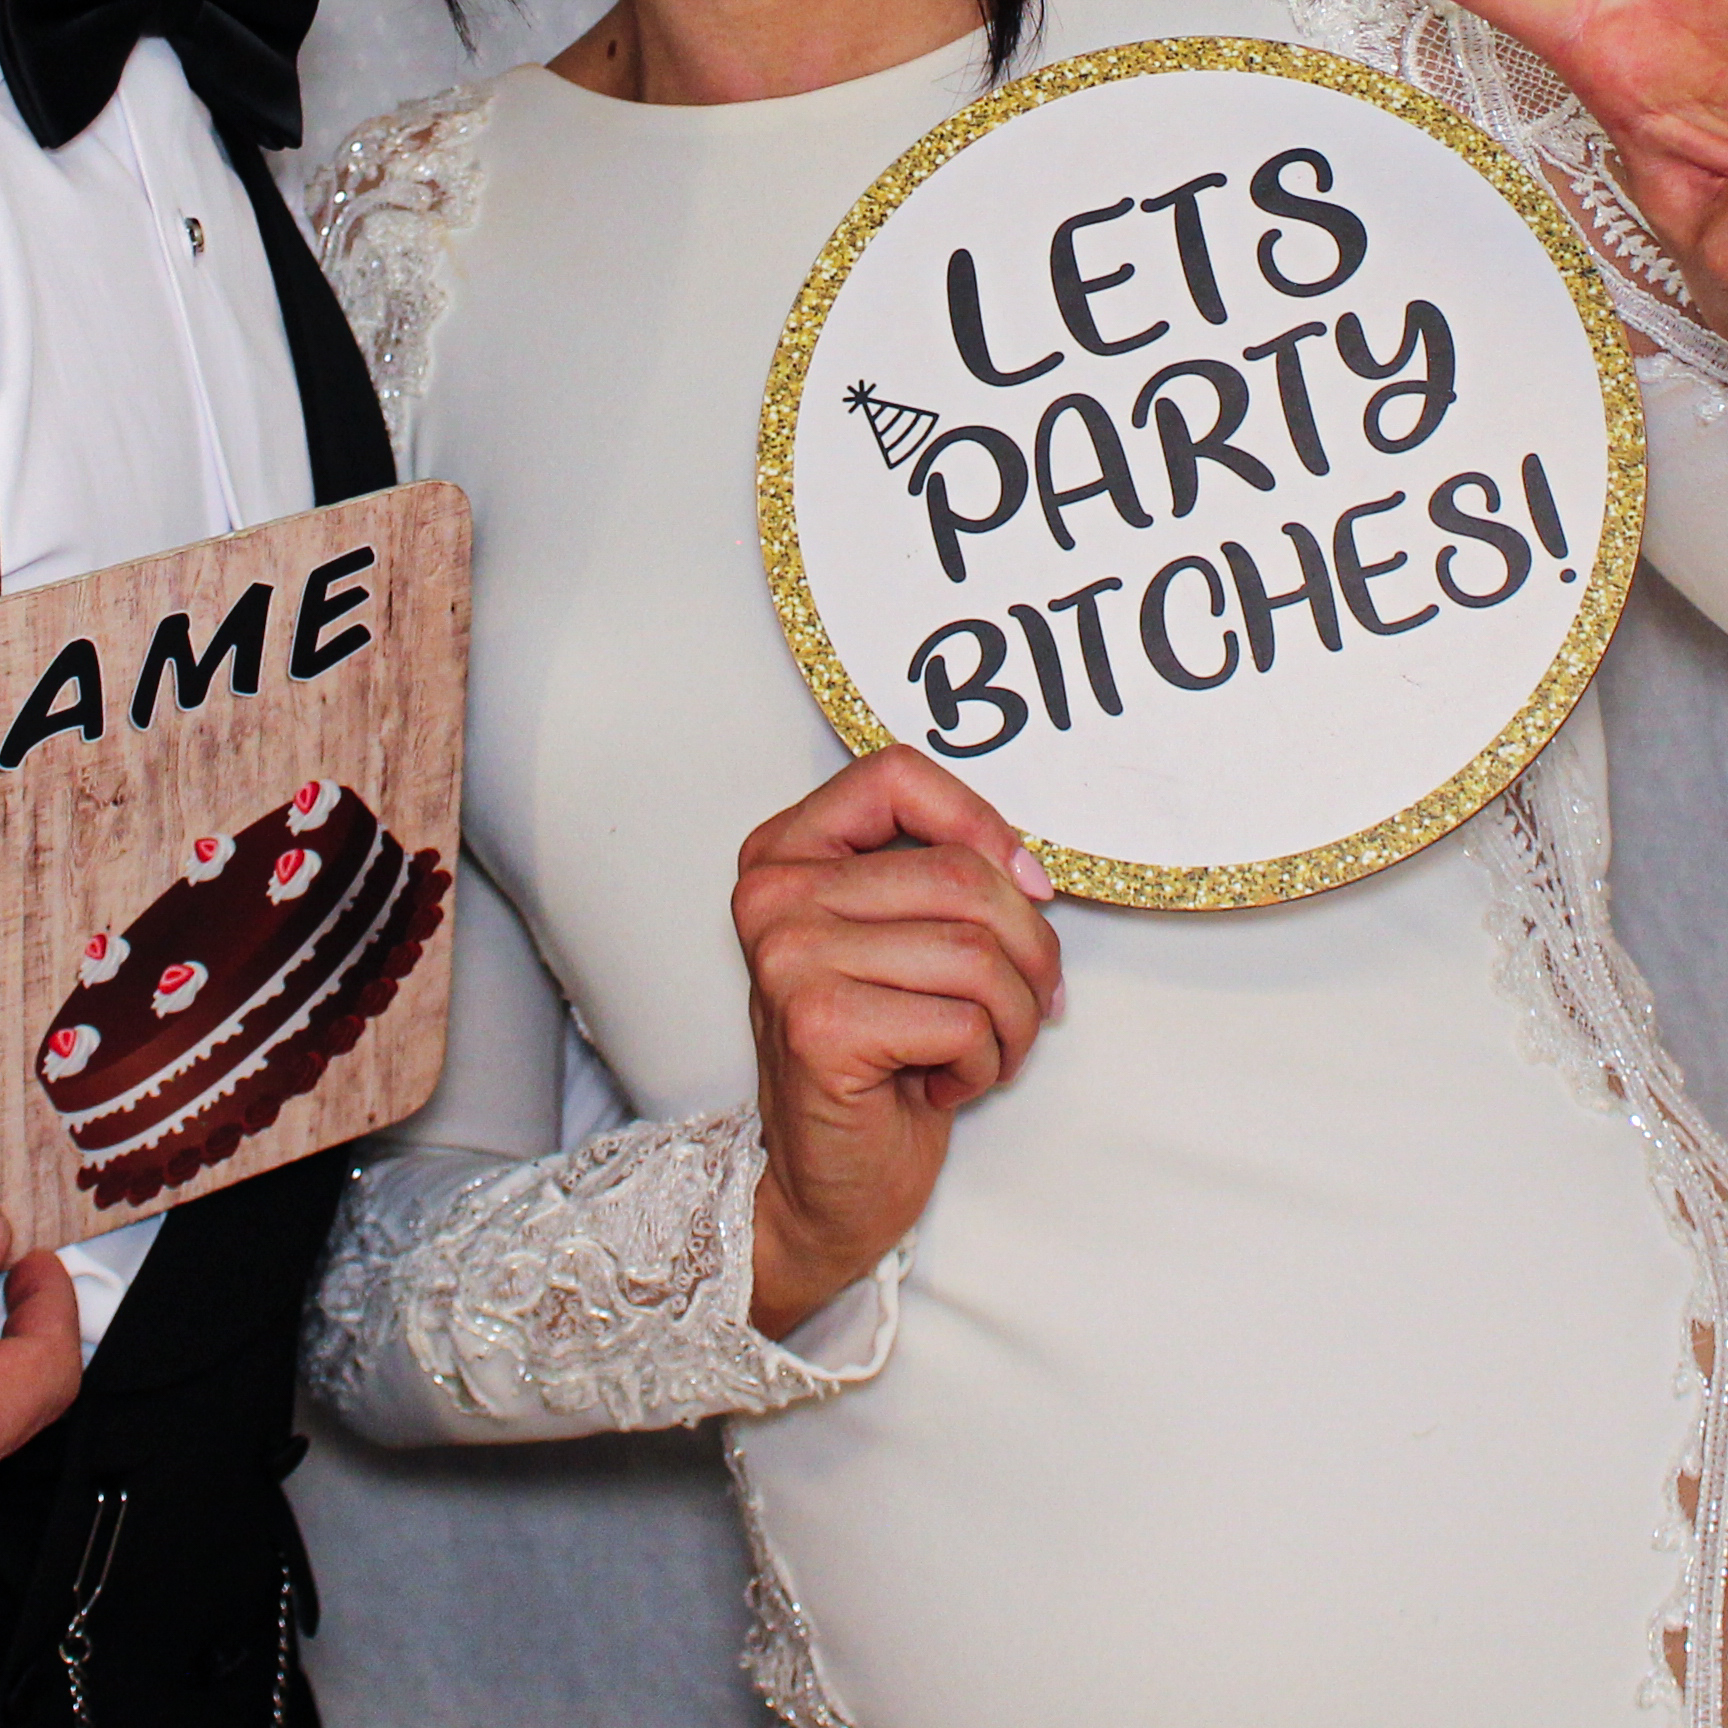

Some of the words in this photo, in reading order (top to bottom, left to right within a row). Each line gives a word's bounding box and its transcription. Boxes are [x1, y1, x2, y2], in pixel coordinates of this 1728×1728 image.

[946, 147, 1368, 386] LETS
[909, 300, 1457, 582] PARTY
[907, 453, 1577, 759] BITCHES!
